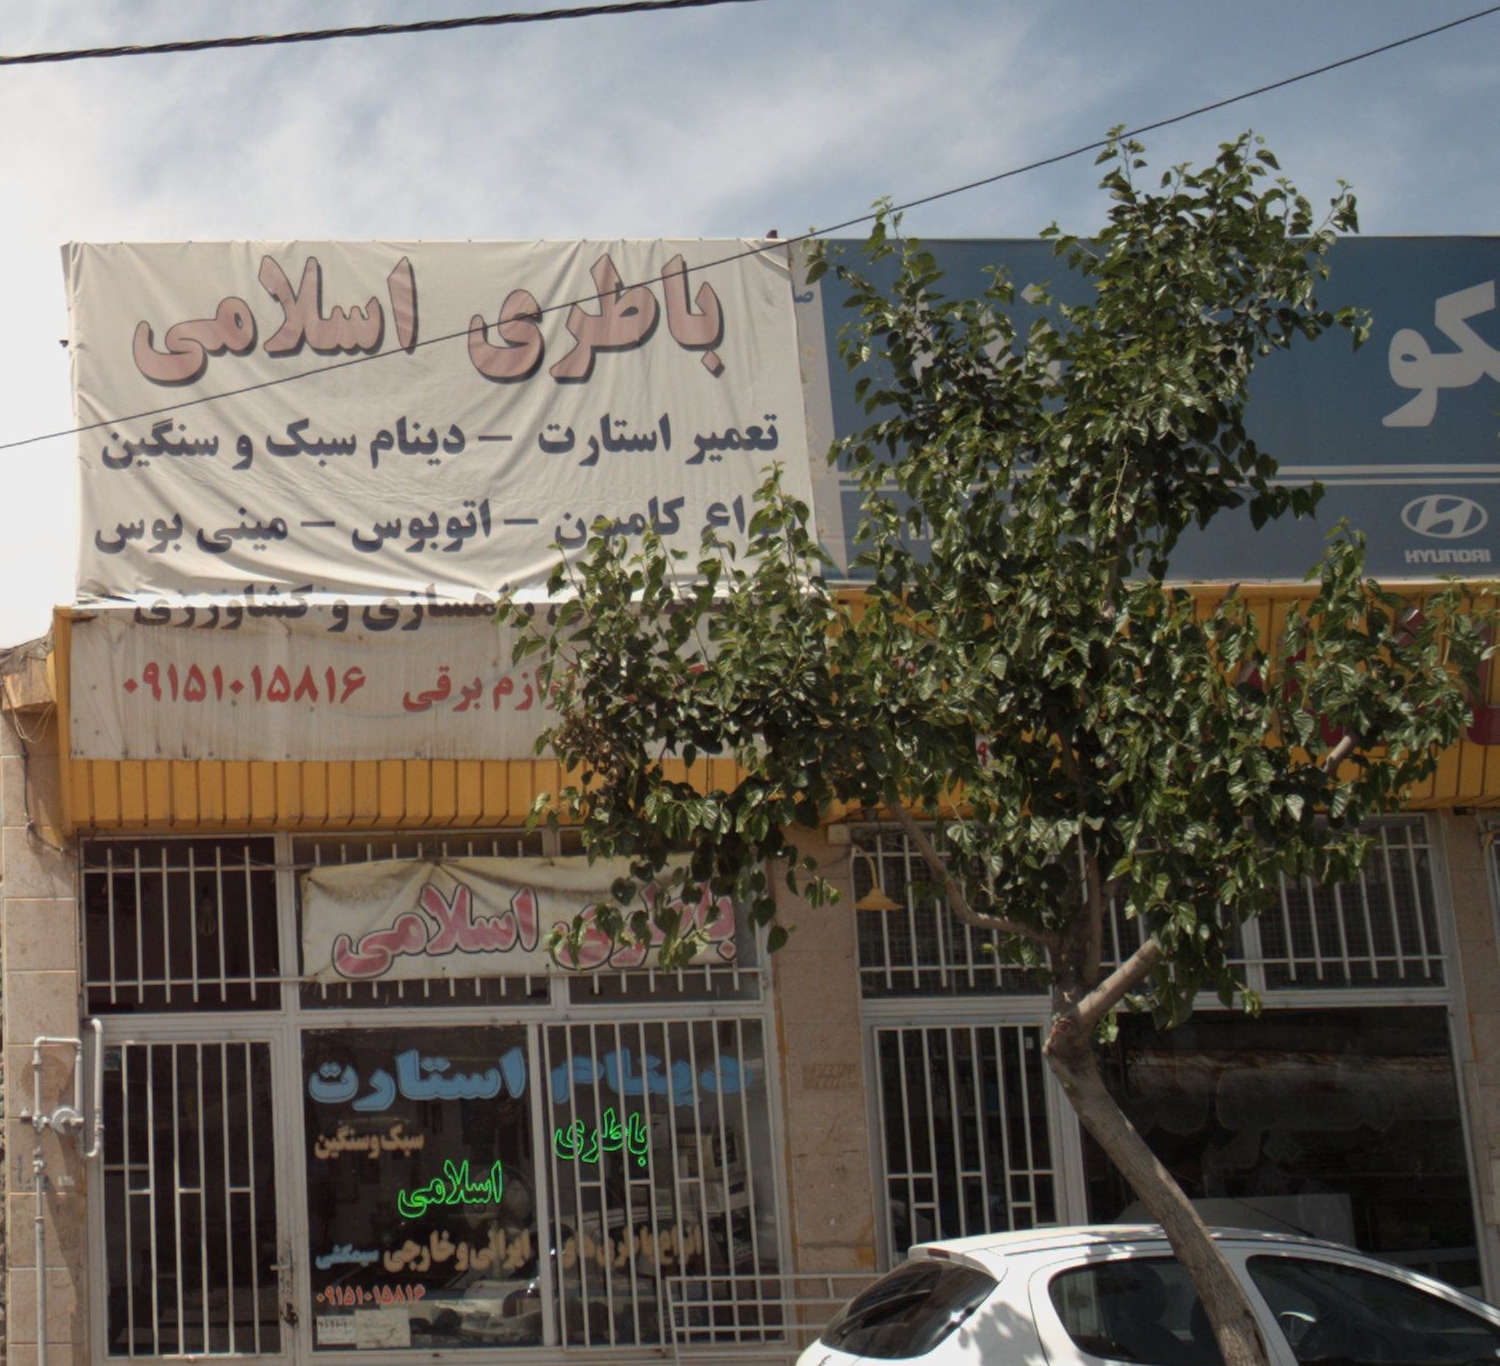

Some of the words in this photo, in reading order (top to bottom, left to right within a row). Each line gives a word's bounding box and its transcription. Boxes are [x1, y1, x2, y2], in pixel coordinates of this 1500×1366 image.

[132, 254, 420, 385] اسلامی
[467, 252, 726, 384] باطری
[101, 419, 220, 469] سنگین
[232, 440, 254, 469] و
[266, 418, 357, 468] سبک
[369, 416, 466, 468] دینام
[537, 414, 670, 468] استارت
[687, 414, 780, 464] تعمیر
[94, 509, 183, 553] بوس
[196, 506, 289, 553] مینی
[351, 499, 491, 556] اتوبوس
[1404, 548, 1492, 564] HYUNDAI
[123, 662, 366, 704] ۰۹۱۵۱۰۱۵۸۱۶
[402, 665, 483, 713] برقی
[331, 884, 538, 978] اسلامی
[308, 1047, 526, 1112] استارت
[550, 1047, 755, 1108] دینام
[554, 1107, 652, 1168] باطری
[398, 1159, 504, 1218] اسلامی
[383, 1229, 456, 1273] خارجی
